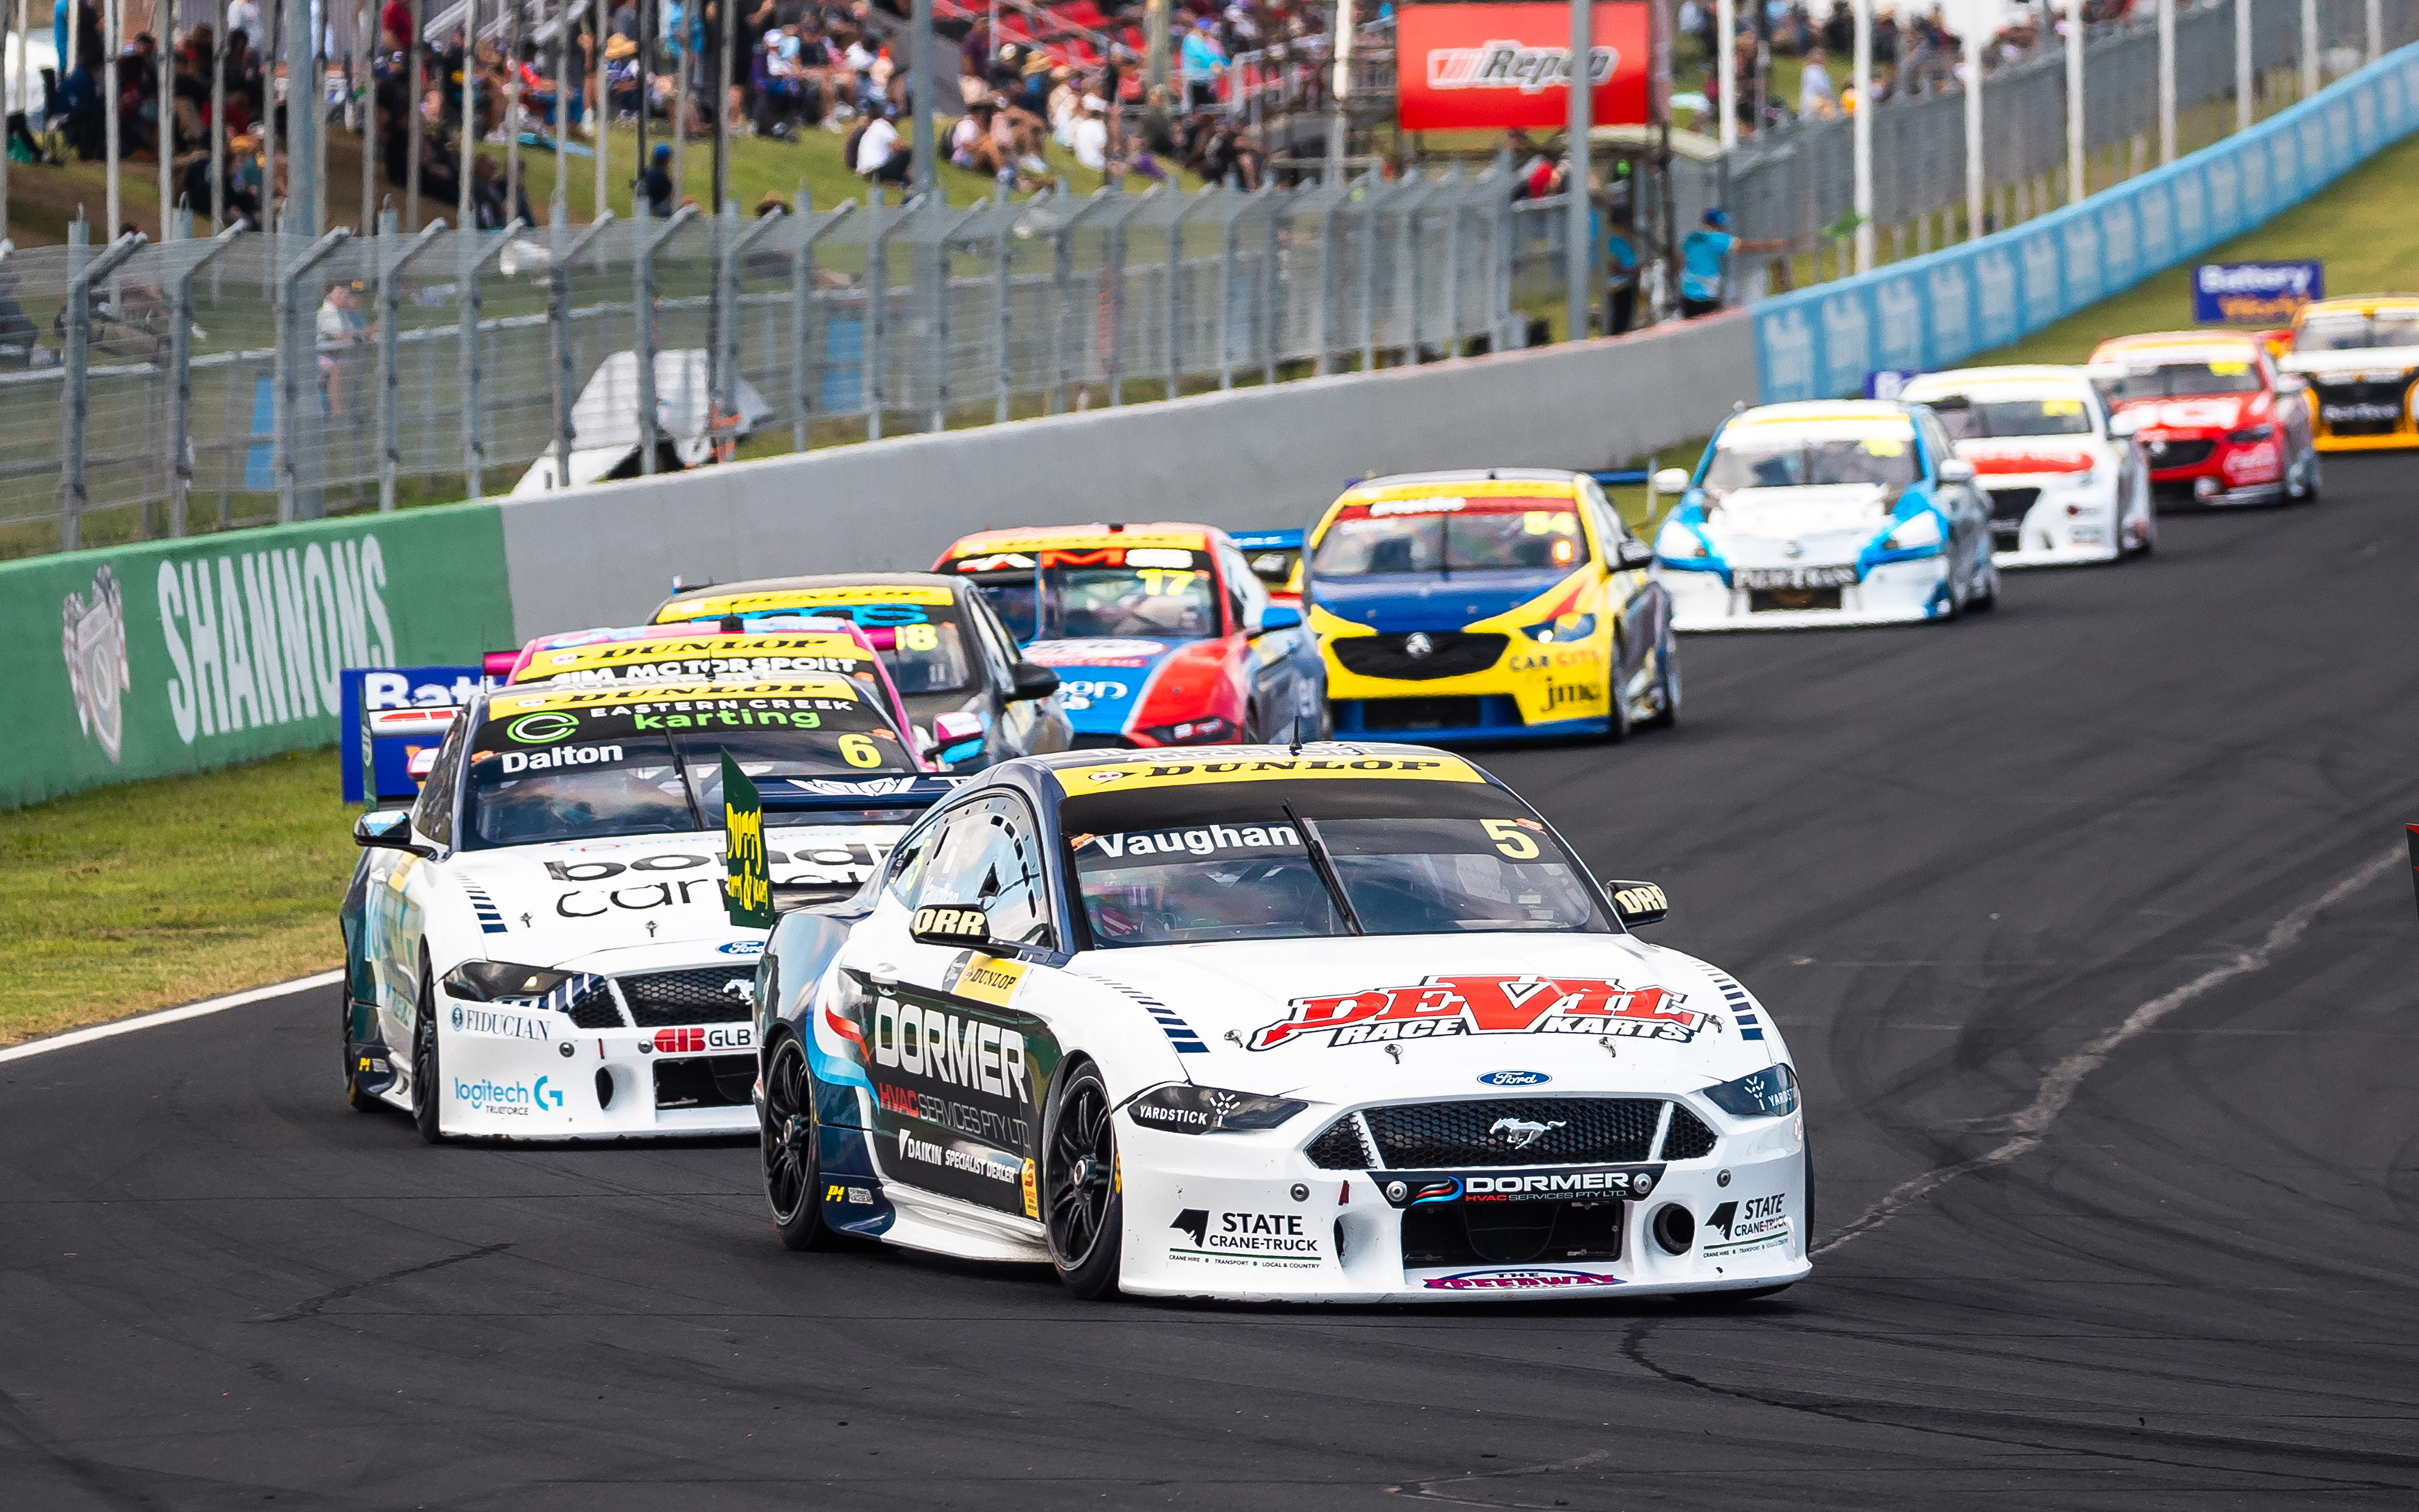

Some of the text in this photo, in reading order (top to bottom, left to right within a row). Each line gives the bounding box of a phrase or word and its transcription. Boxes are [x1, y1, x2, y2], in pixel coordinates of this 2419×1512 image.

[1482, 47, 1610, 86] Repo
[1136, 569, 1196, 596] 17
[157, 533, 395, 744] SHANNONS
[593, 639, 828, 660] DUNLOP
[625, 657, 859, 679] MOTORSPORT
[563, 685, 825, 703] DUNLOP
[590, 699, 853, 718] EASTERN CREEK
[634, 709, 822, 730] karting
[502, 744, 623, 774] Dalton
[837, 733, 882, 769] 6
[1149, 761, 1441, 778] DUNLOP
[1095, 822, 1300, 859] Vaughan
[1478, 818, 1540, 861] 5
[969, 968, 1017, 990] DUNLOP
[1257, 975, 1708, 1048] DEVIL
[466, 1010, 552, 1041] FIDUCIAN
[709, 1029, 751, 1046] GLB
[1337, 1016, 1693, 1046] RACE KARTS
[875, 996, 1029, 1104] DORMER
[1493, 1071, 1538, 1085] Ford
[455, 1077, 529, 1109] logitech
[879, 1082, 919, 1118] HVAC
[917, 1094, 981, 1134] SERVICES
[1139, 1106, 1208, 1125] YARDSTICK
[908, 1138, 1017, 1184] DAIKIN SPECIALIST DEALER
[1466, 1173, 1630, 1192] DORMER
[1508, 1192, 1573, 1201] SERVICES
[1744, 1192, 1785, 1220] STATE
[1222, 1213, 1304, 1236] STATE
[1209, 1234, 1318, 1252] CRANE-TRUCK
